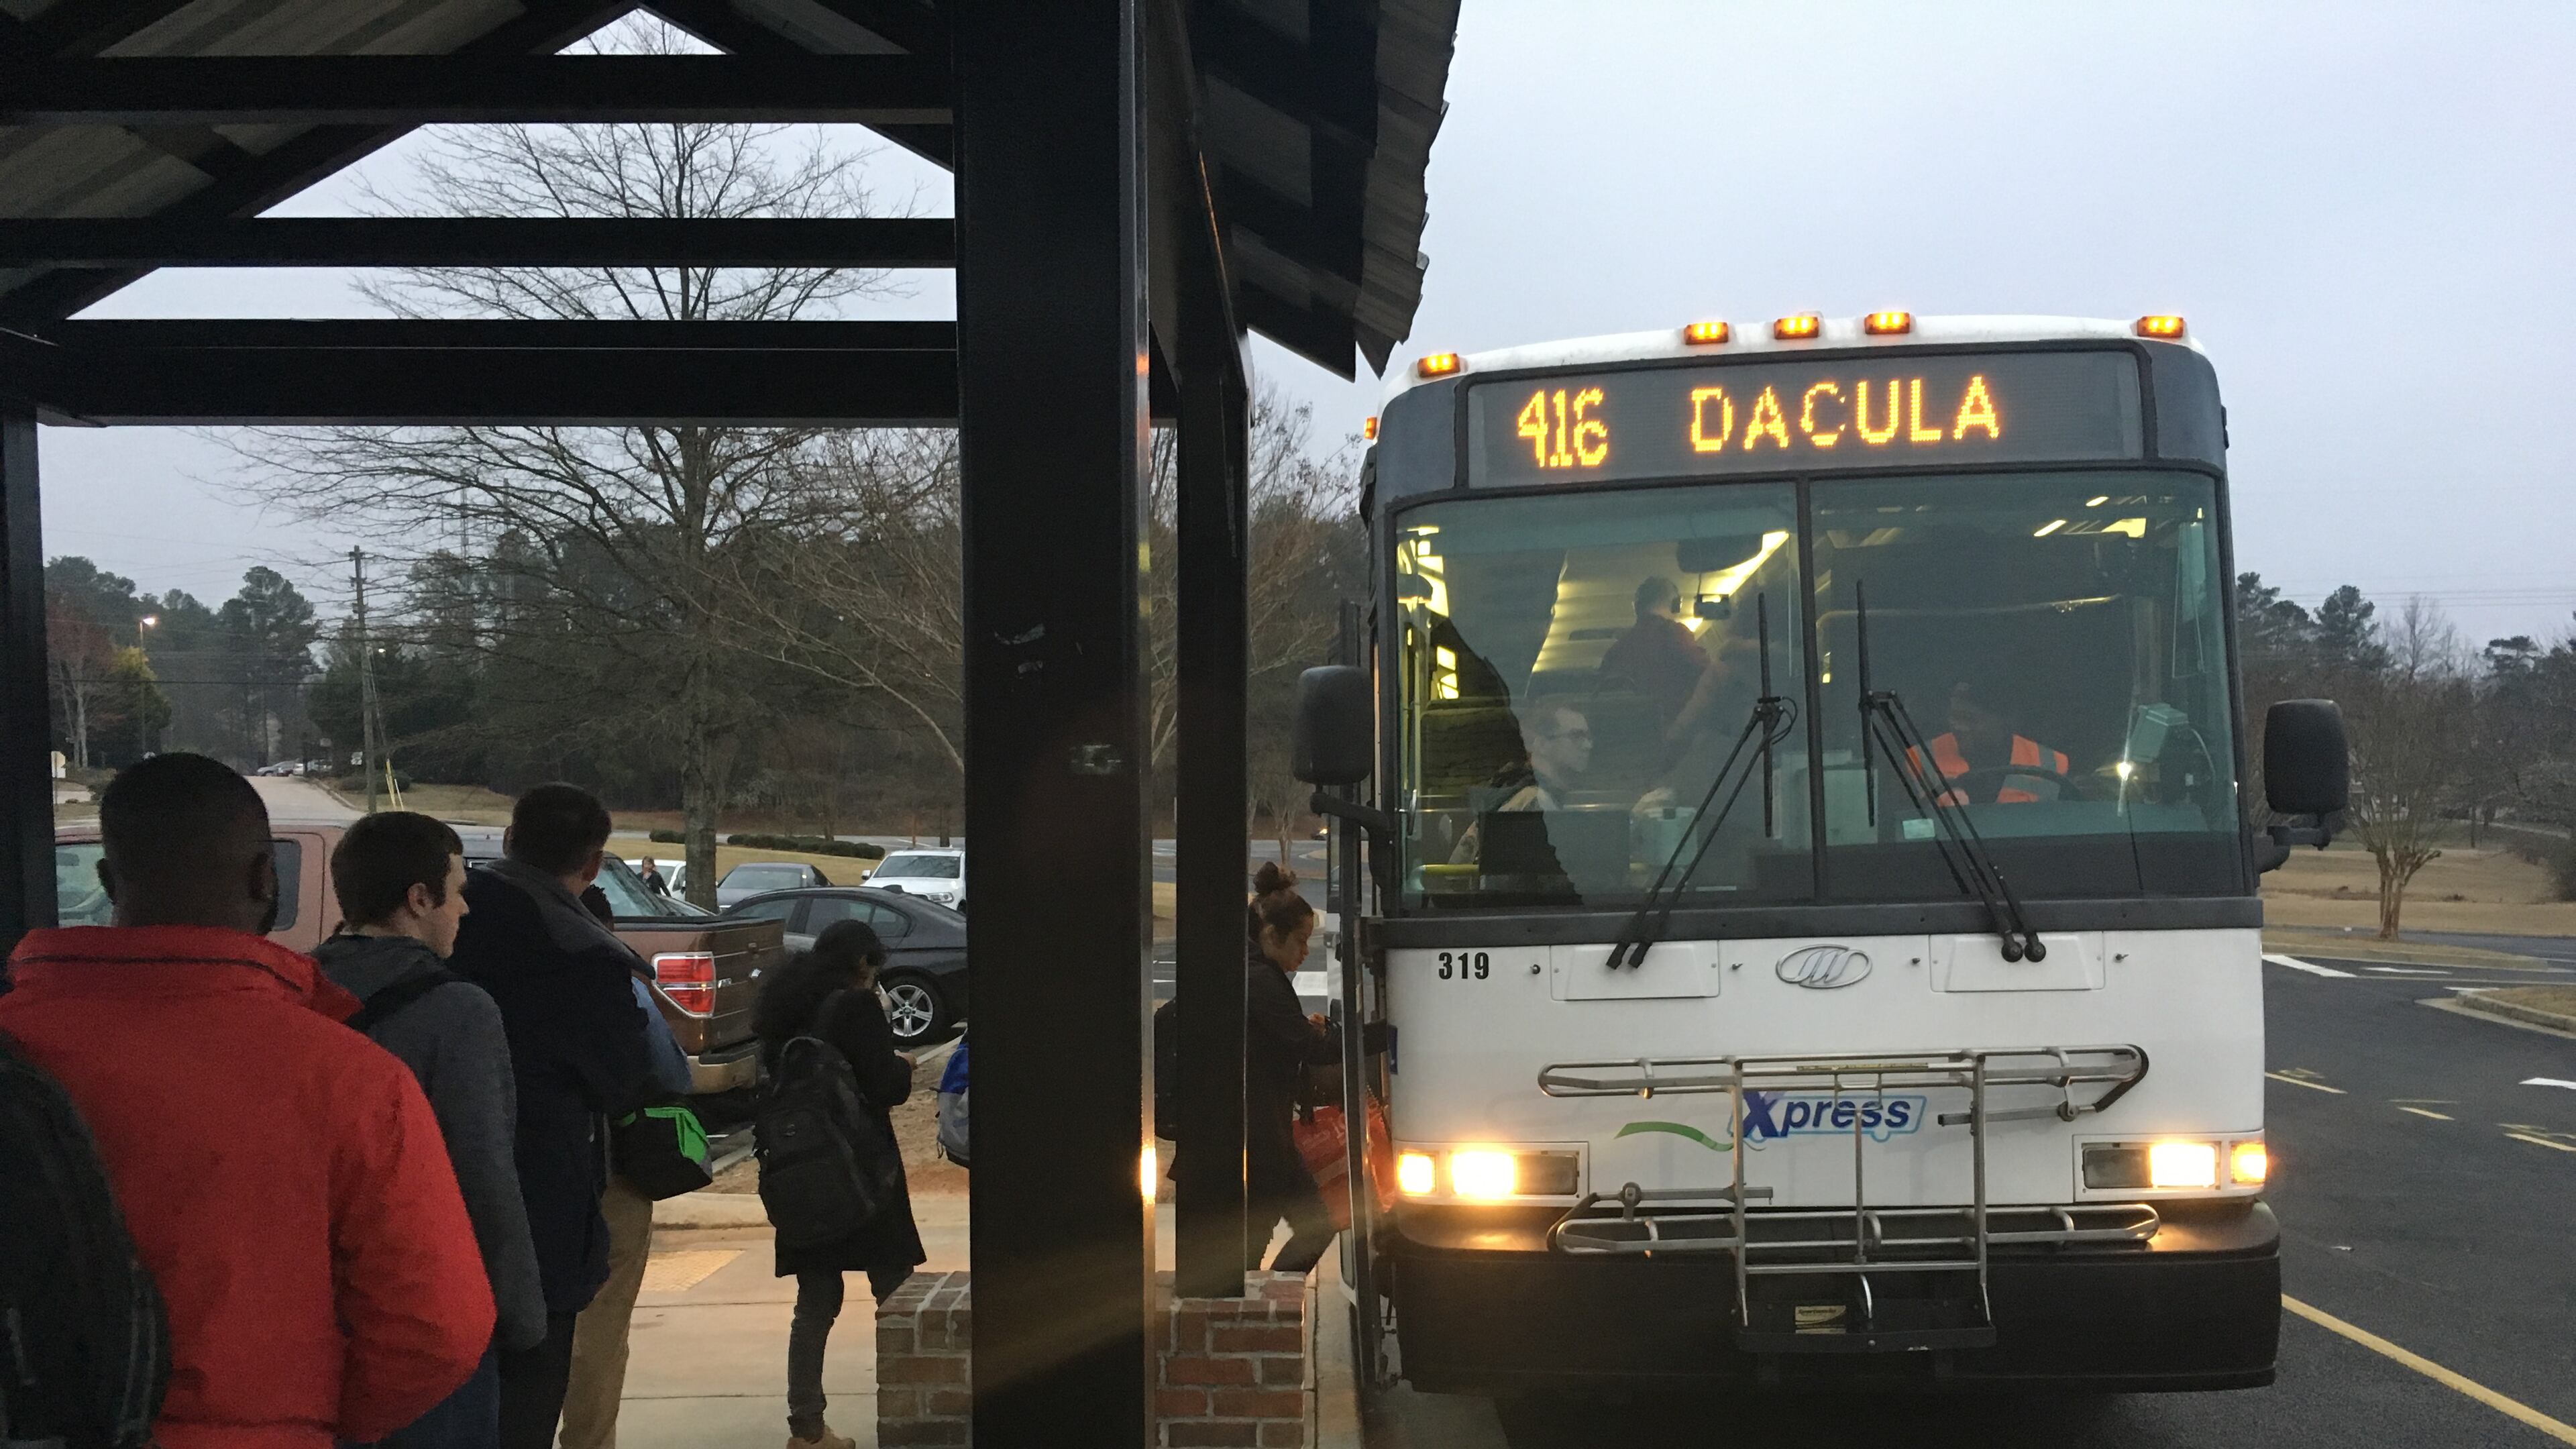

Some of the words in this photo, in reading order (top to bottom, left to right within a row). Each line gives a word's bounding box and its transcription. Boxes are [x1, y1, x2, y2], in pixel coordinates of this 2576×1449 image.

[1517, 387, 1609, 470] 416
[1690, 376, 2002, 453] DACULA
[1438, 953, 1489, 979] 319
[1737, 1091, 1911, 1138] Xpress
